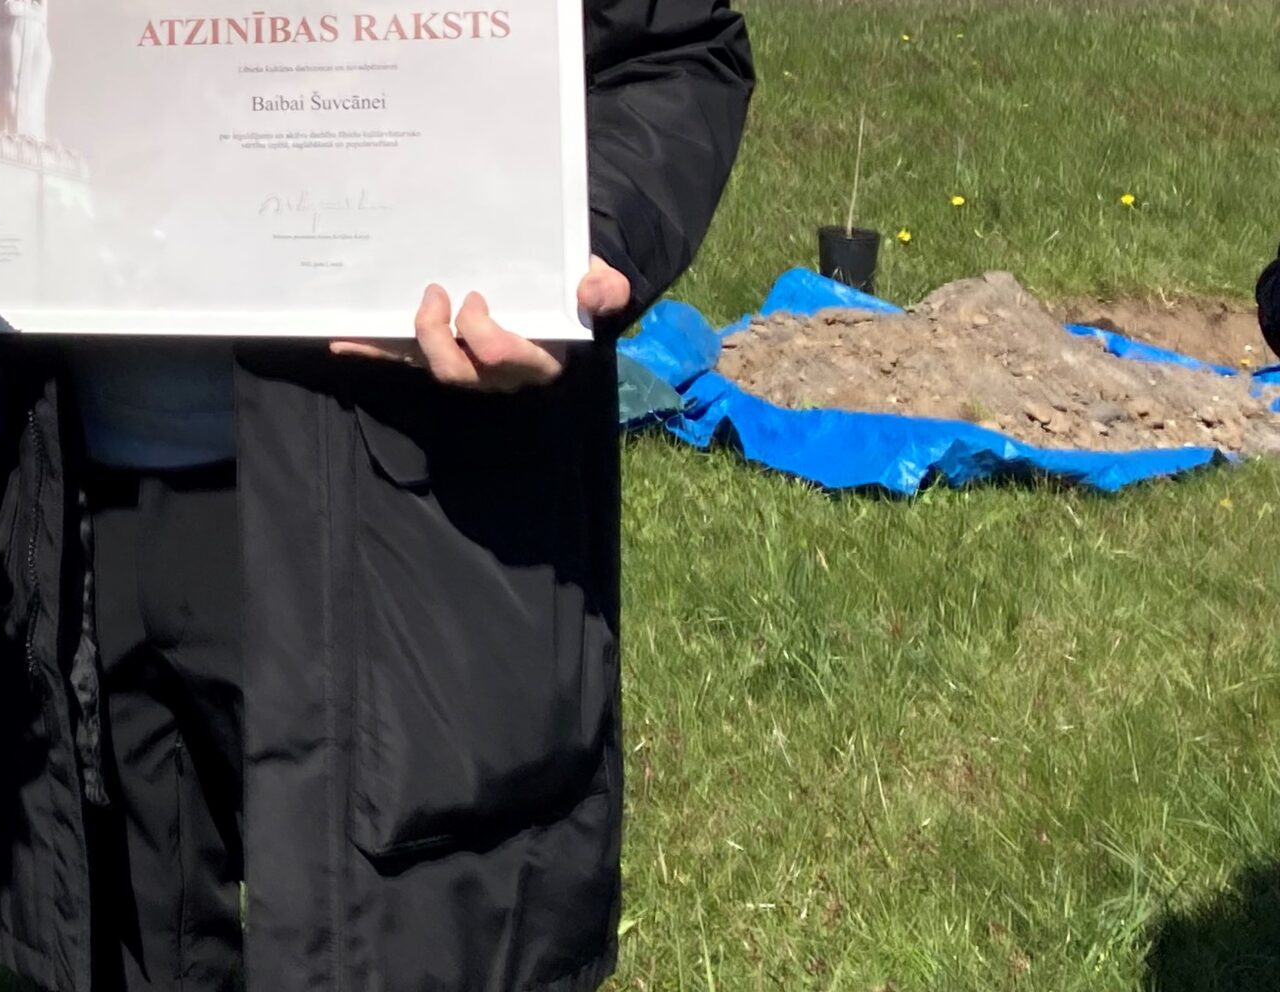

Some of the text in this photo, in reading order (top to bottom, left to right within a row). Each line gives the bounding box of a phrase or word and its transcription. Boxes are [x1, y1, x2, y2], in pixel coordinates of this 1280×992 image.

[137, 10, 511, 47] ATZINĪBAS RAKSTS
[251, 91, 387, 112] Baibai Šuvcānei
